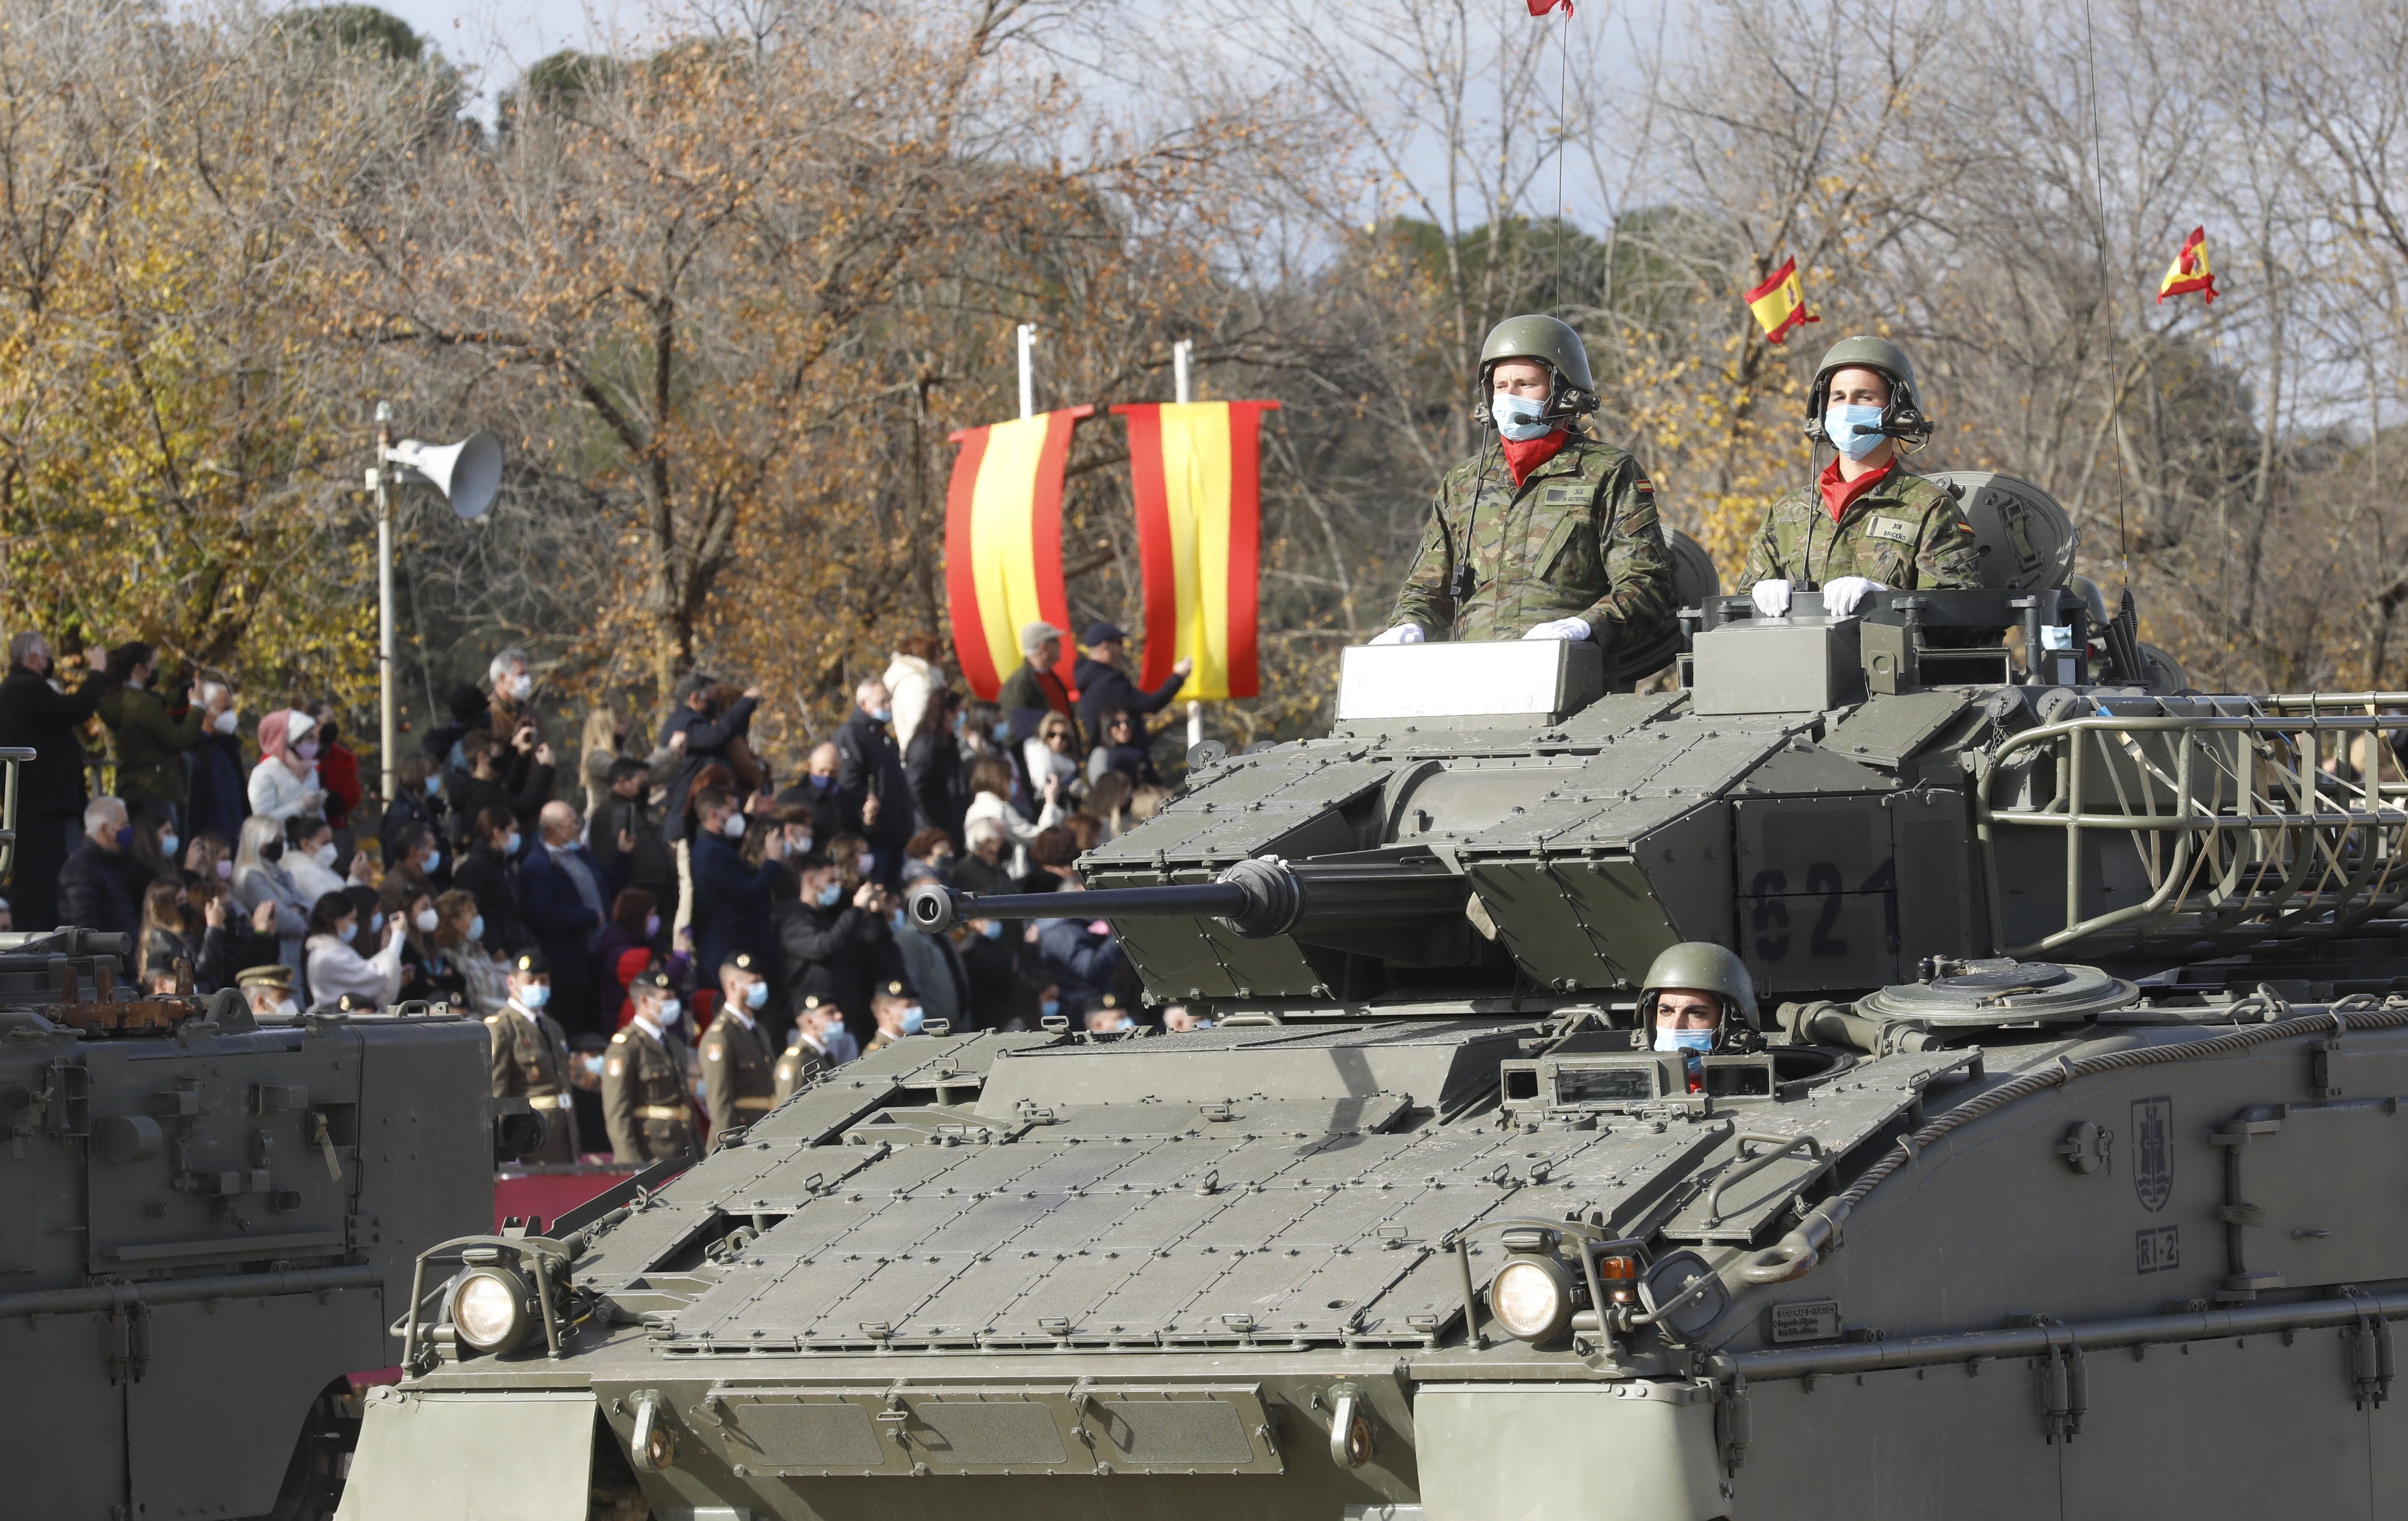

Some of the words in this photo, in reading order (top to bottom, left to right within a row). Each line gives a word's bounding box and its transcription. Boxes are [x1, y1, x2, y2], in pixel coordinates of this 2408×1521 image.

[1883, 530, 1906, 541] BRICEÑO
[1753, 857, 1900, 962] 621
[2141, 1234, 2175, 1266] RI-2
[1778, 1309, 1806, 1318] GENERAL
[1807, 1305, 1837, 1316] DYNAMICS
